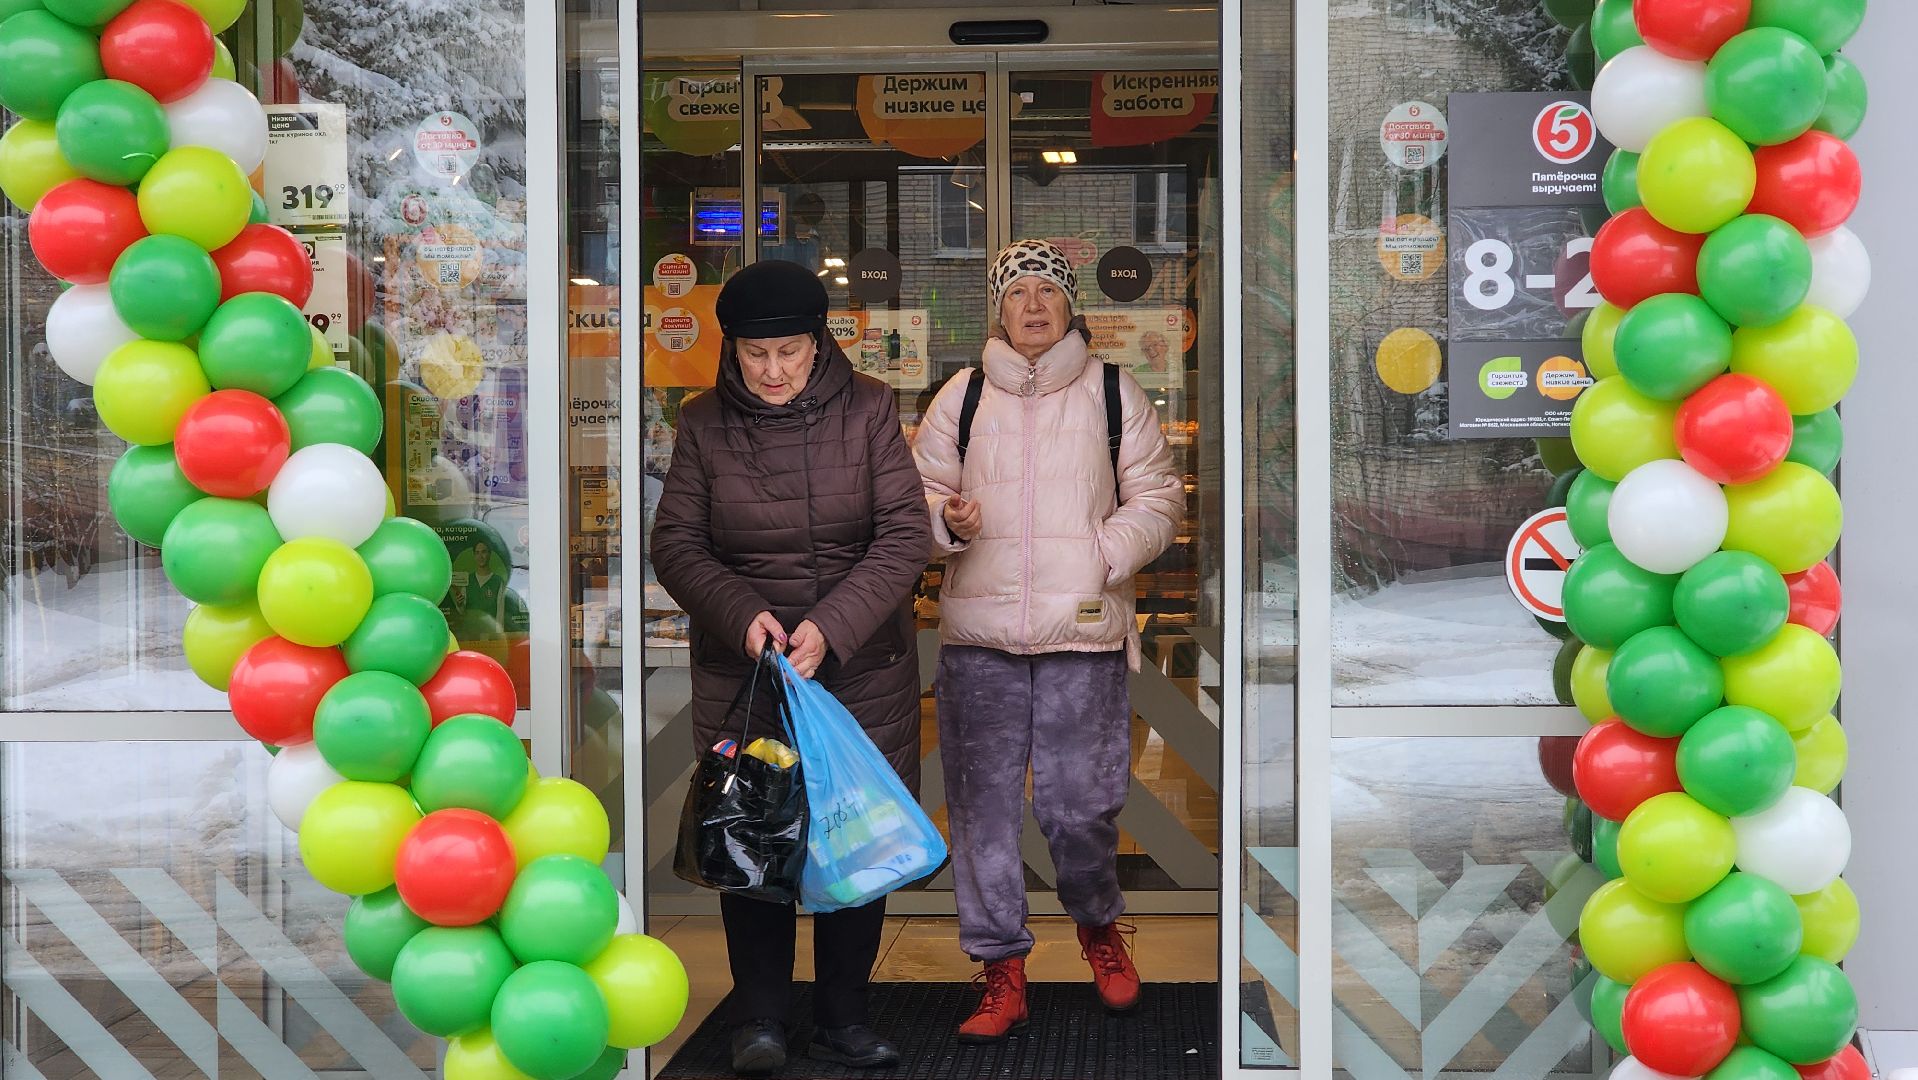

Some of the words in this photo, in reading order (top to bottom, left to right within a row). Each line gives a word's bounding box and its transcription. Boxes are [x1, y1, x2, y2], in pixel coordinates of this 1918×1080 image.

[679, 80, 769, 97] Гараня
[883, 76, 968, 95] Держим
[1113, 75, 1218, 92] Искренняя
[679, 102, 770, 115] свежеи
[884, 100, 955, 113] низкие
[962, 99, 986, 114] це
[1114, 95, 1184, 111] забота
[1389, 122, 1431, 130] Доставка
[1412, 132, 1441, 140] минут
[1532, 171, 1597, 183] Пятёрочка
[1532, 183, 1597, 195] выручает!
[282, 184, 334, 210] 319
[334, 183, 346, 192] 99
[861, 270, 888, 281] ВХОД
[1111, 269, 1138, 279] ВХОД
